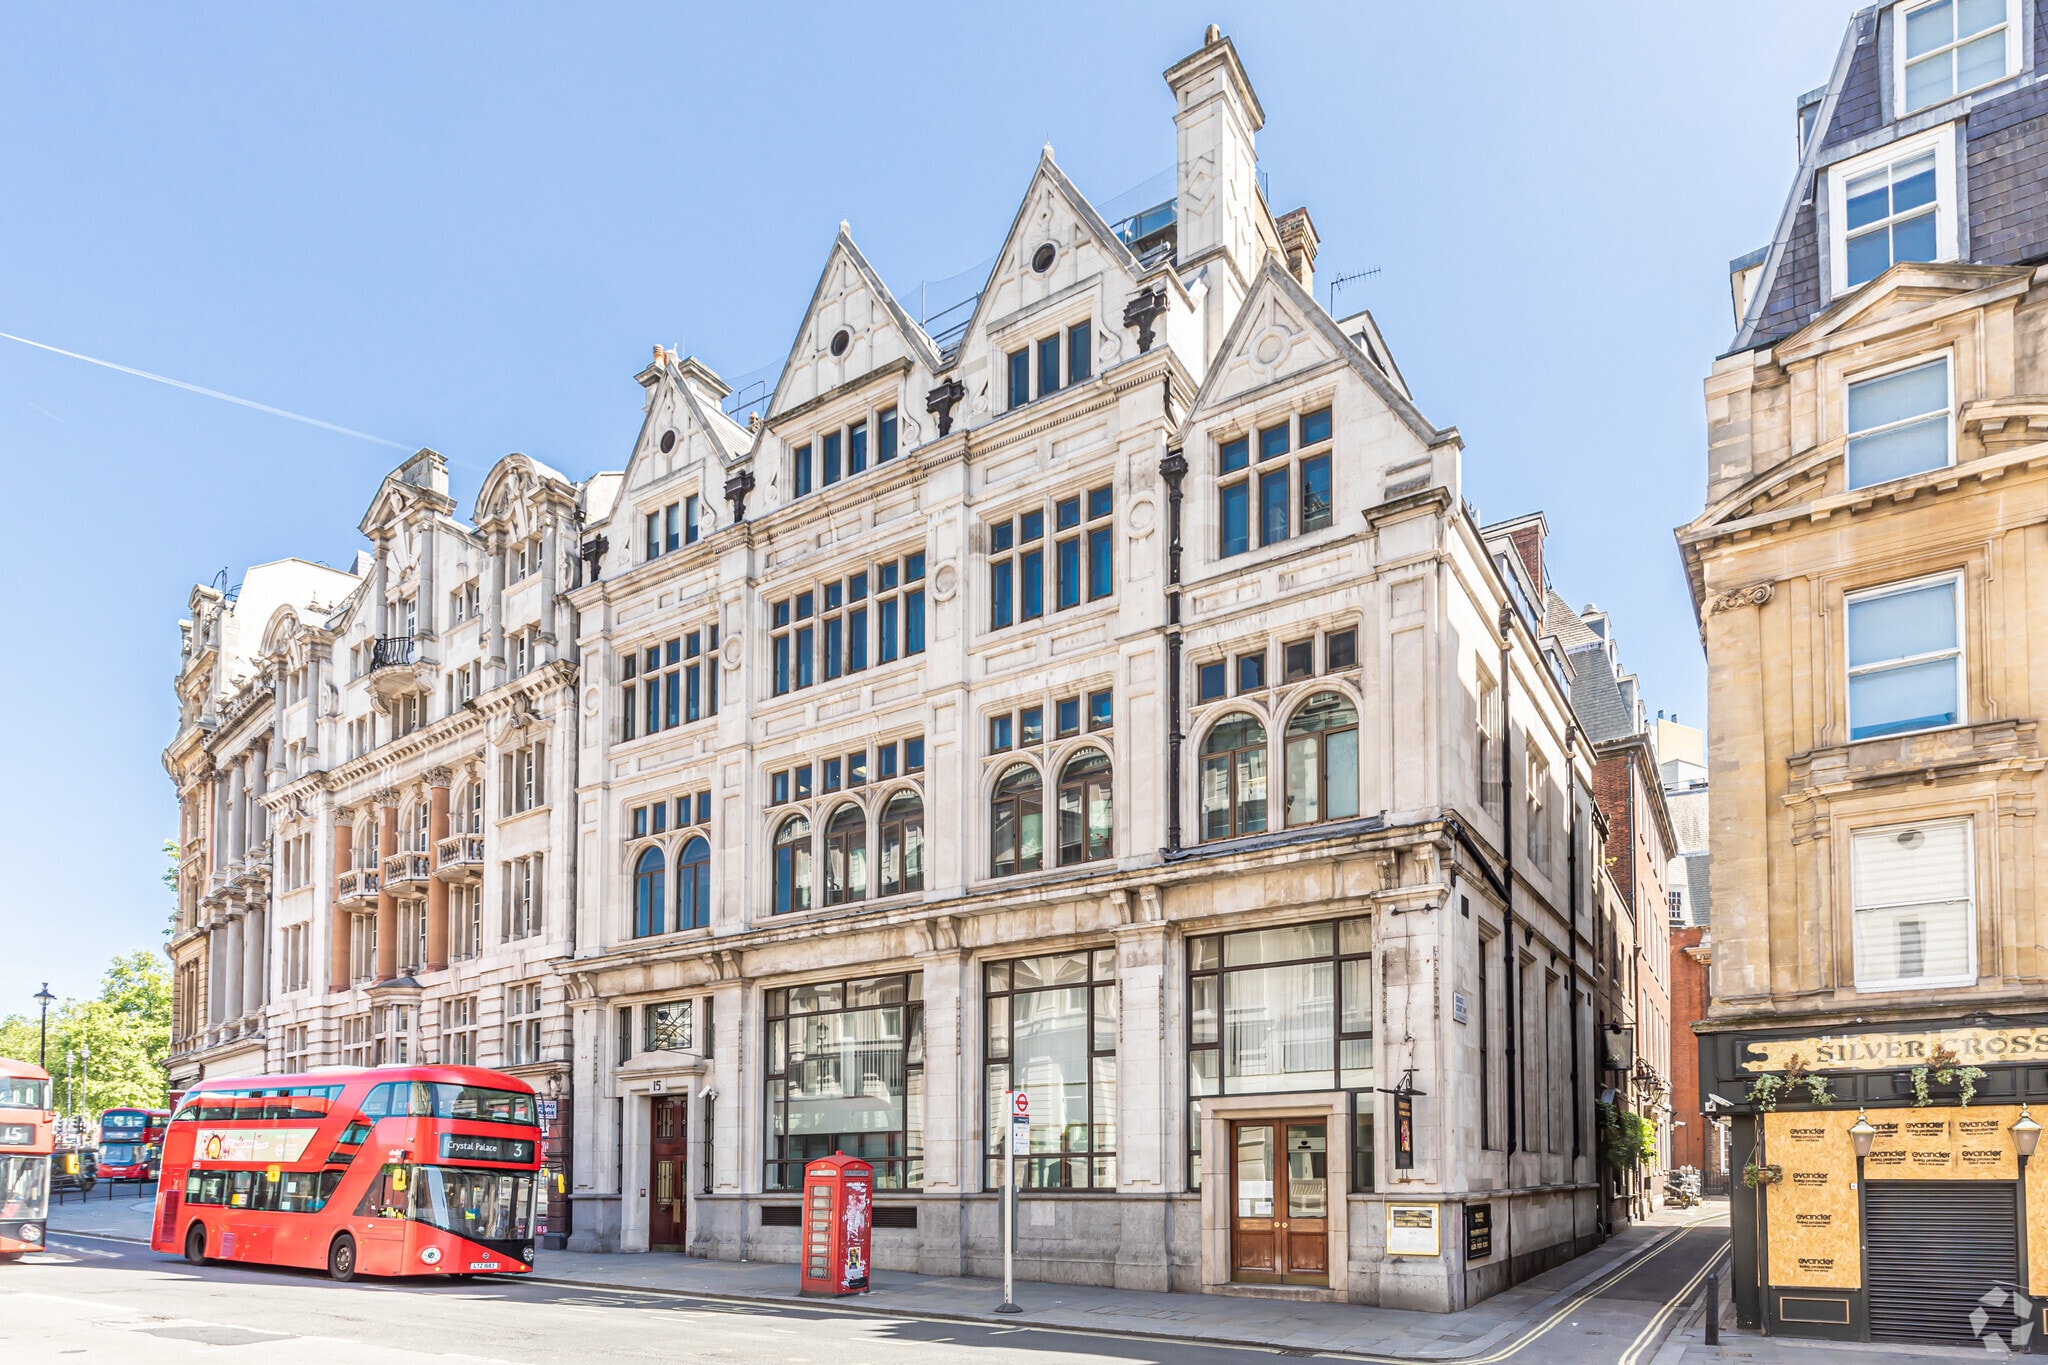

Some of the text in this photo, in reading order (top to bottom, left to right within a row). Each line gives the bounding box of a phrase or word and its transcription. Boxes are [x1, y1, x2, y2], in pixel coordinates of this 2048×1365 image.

[1817, 1040, 1925, 1063] SILVER
[653, 1080, 661, 1091] 15
[1905, 1121, 1944, 1129] evander
[1959, 1120, 1999, 1128] evander
[4, 1127, 22, 1140] 15
[447, 1140, 498, 1152] Crystal Palace
[513, 1143, 523, 1157] 3
[1869, 1150, 1907, 1158] evander
